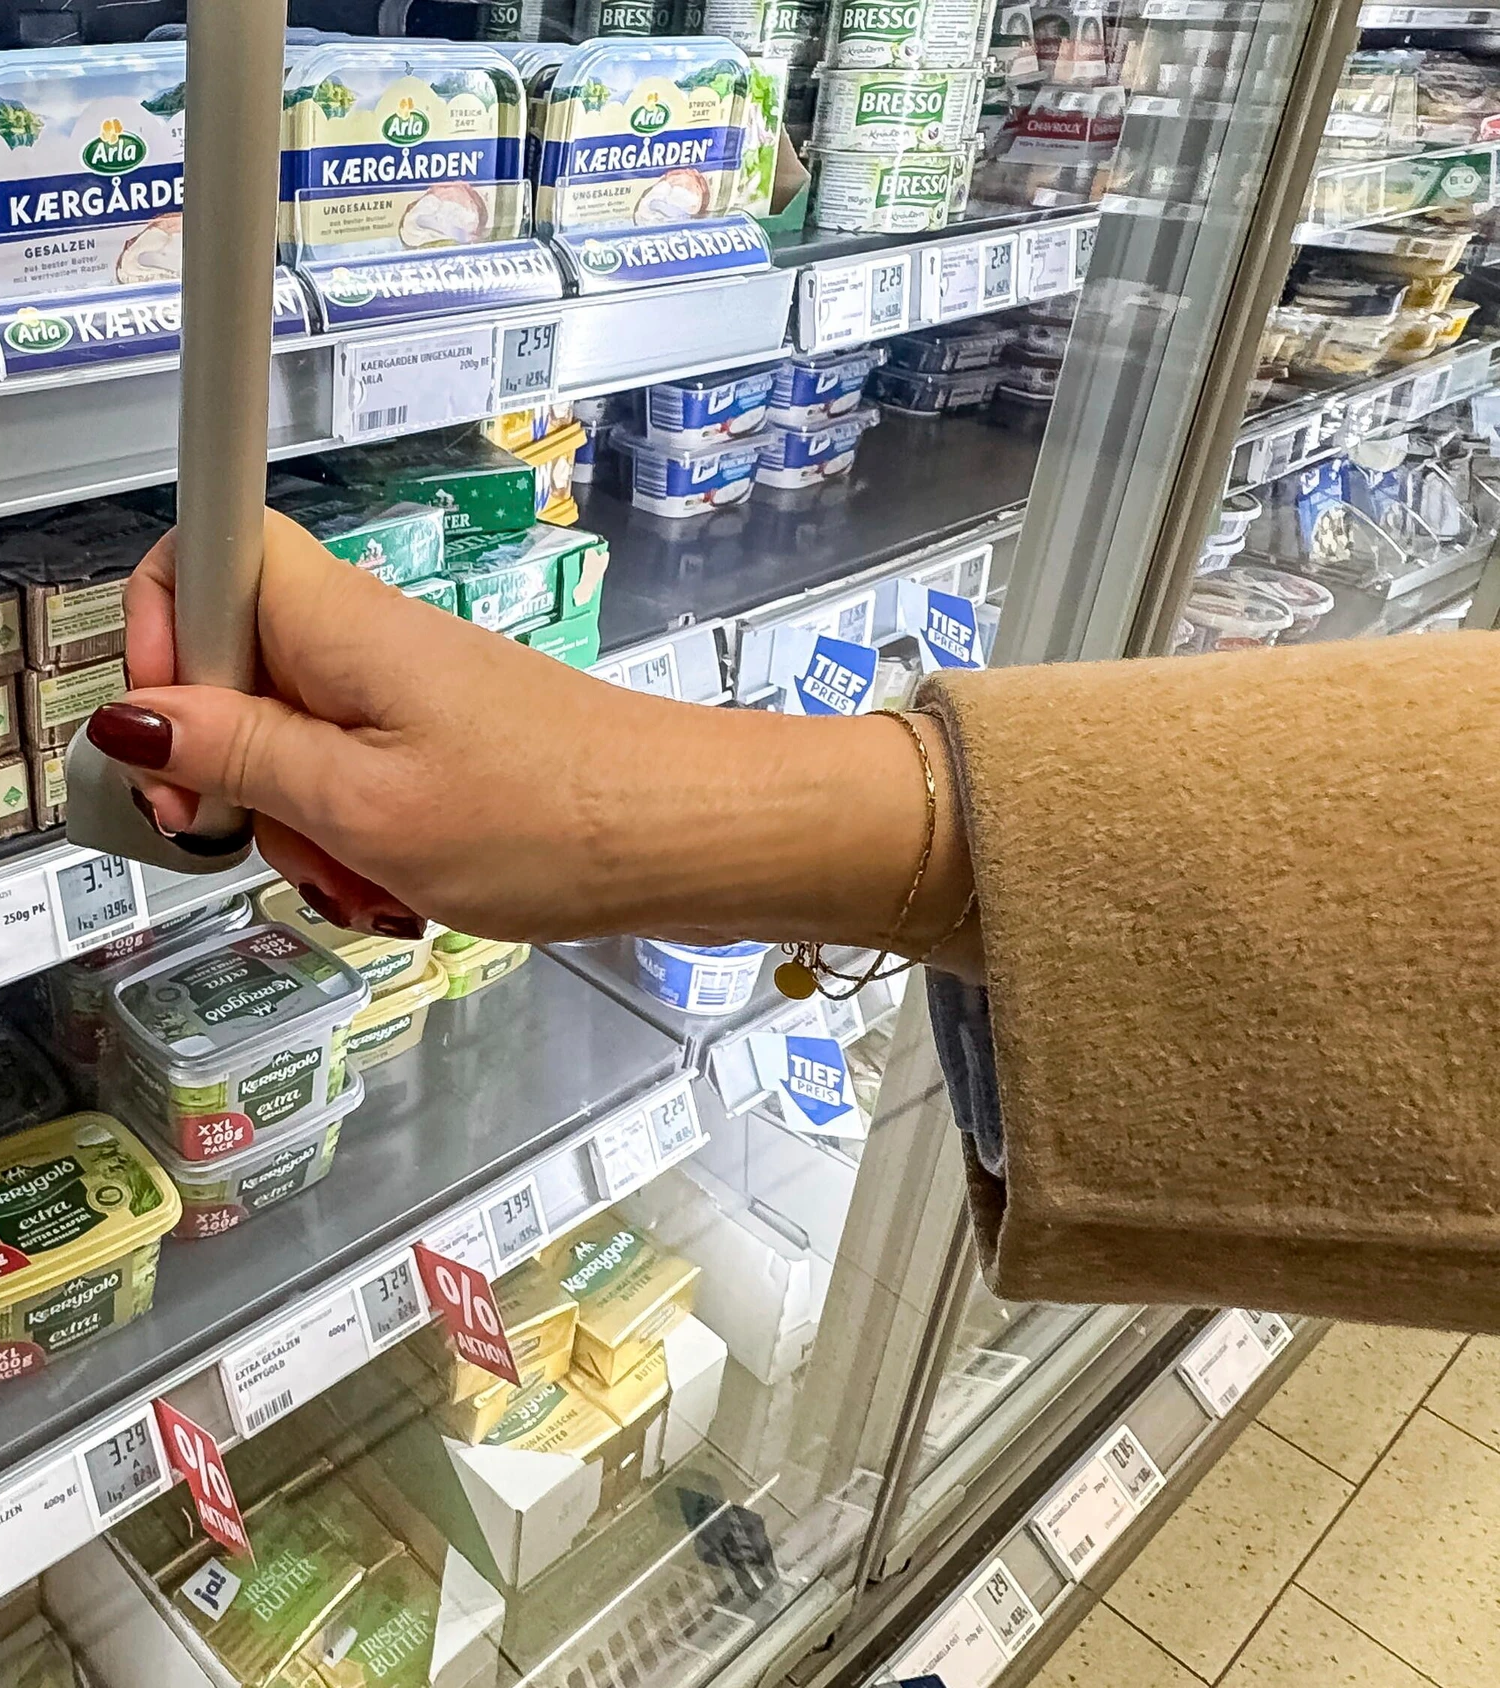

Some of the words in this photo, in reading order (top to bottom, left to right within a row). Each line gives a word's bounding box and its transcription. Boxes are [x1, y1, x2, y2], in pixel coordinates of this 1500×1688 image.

[842, 7, 922, 31] BRESSO
[634, 107, 666, 127] Arla
[861, 92, 942, 115] BRESSO
[387, 117, 423, 136] Arla
[91, 142, 137, 165] Arla
[322, 147, 479, 186] KÆRGÅRDEN
[574, 138, 709, 174] KÆRGÅRDEN
[572, 185, 632, 201] UNGESALZEN
[880, 174, 947, 197] BRESSO
[323, 200, 393, 215] UNGESALZEN
[24, 238, 96, 260] GESALZEN
[587, 252, 618, 267] Arla
[619, 225, 762, 268] KÆRGÅRDEN
[17, 324, 62, 344] Arla
[517, 325, 551, 358] 2.59
[360, 354, 419, 373] KAERGARDEN
[420, 345, 474, 364] UNGESALZEN
[929, 607, 973, 645] TIEF
[933, 631, 967, 658] PREIS
[813, 654, 868, 696] TIEF
[809, 680, 850, 713] PREIS
[83, 856, 125, 894] 3.49
[3, 908, 30, 926] 250g
[32, 902, 47, 916] PK
[204, 978, 300, 1023] Kerrygold
[241, 1050, 321, 1096] Kerrygold
[789, 1053, 843, 1089] TIEF
[256, 1088, 303, 1118] extra
[796, 1080, 836, 1102] PREIS
[197, 1117, 235, 1136] XXL
[202, 1126, 245, 1147] 400g
[204, 1140, 236, 1156] PACK
[241, 1145, 317, 1191] Kerrygold
[18, 1199, 73, 1231] extra
[503, 1188, 532, 1225] 3.99
[560, 1230, 635, 1294] Kerrygold
[29, 1273, 120, 1326] Kerrygold
[380, 1265, 408, 1303] 3.29
[49, 1311, 102, 1343] extra
[235, 1359, 261, 1383] EXTRA
[261, 1335, 302, 1370] GESALZEN
[457, 1330, 513, 1371] AKTION
[108, 1422, 147, 1467] 3.29
[199, 1499, 247, 1549] AKTION
[194, 1568, 228, 1612] ja!
[244, 1549, 300, 1605] IRISCHE
[254, 1556, 319, 1623] BUTTER
[359, 1605, 417, 1660] IRISCHE
[369, 1621, 432, 1680] BUTTER
